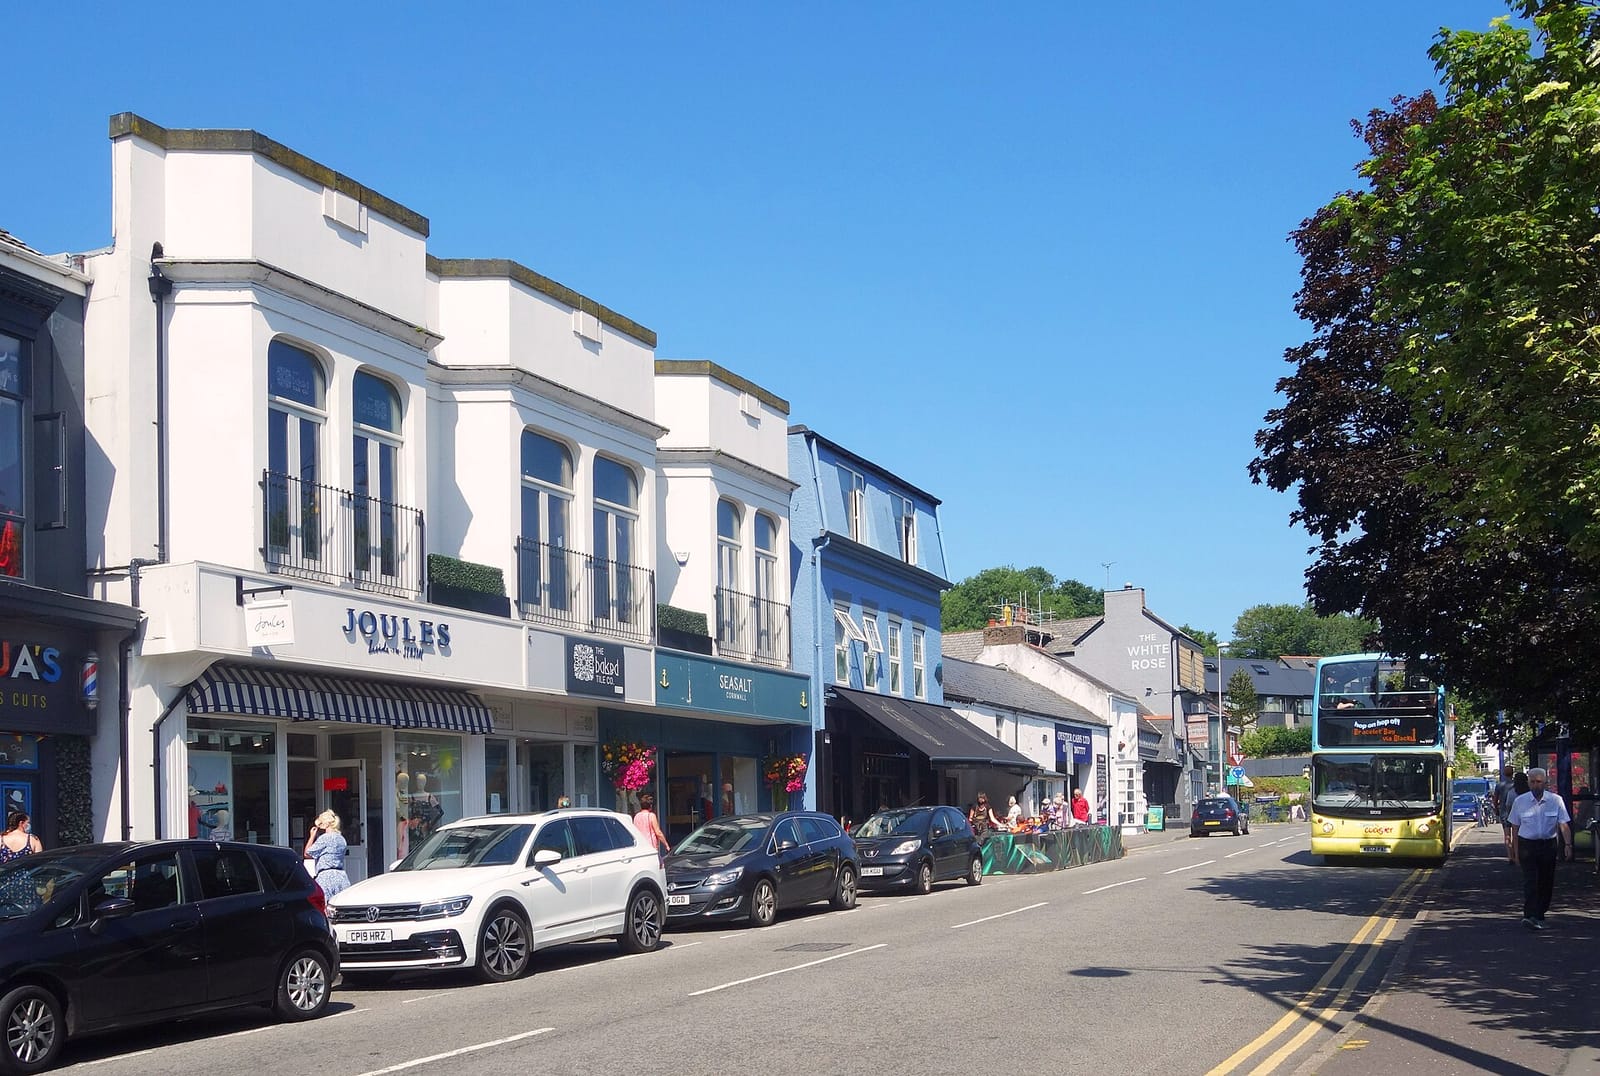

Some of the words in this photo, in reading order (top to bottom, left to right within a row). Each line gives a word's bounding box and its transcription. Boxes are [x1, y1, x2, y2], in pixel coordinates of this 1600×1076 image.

[342, 608, 451, 648] JOULES
[1139, 633, 1157, 642] THE
[595, 646, 604, 655] THE
[1127, 643, 1169, 657] WHITE
[595, 655, 619, 676] baked
[1131, 657, 1166, 670] ROSE
[595, 674, 606, 684] TILE
[719, 674, 753, 693] SEASALT
[12, 692, 47, 709] CUTS
[1354, 721, 1367, 730] hop
[350, 932, 368, 942] CP19
[369, 931, 386, 941] HRZ
